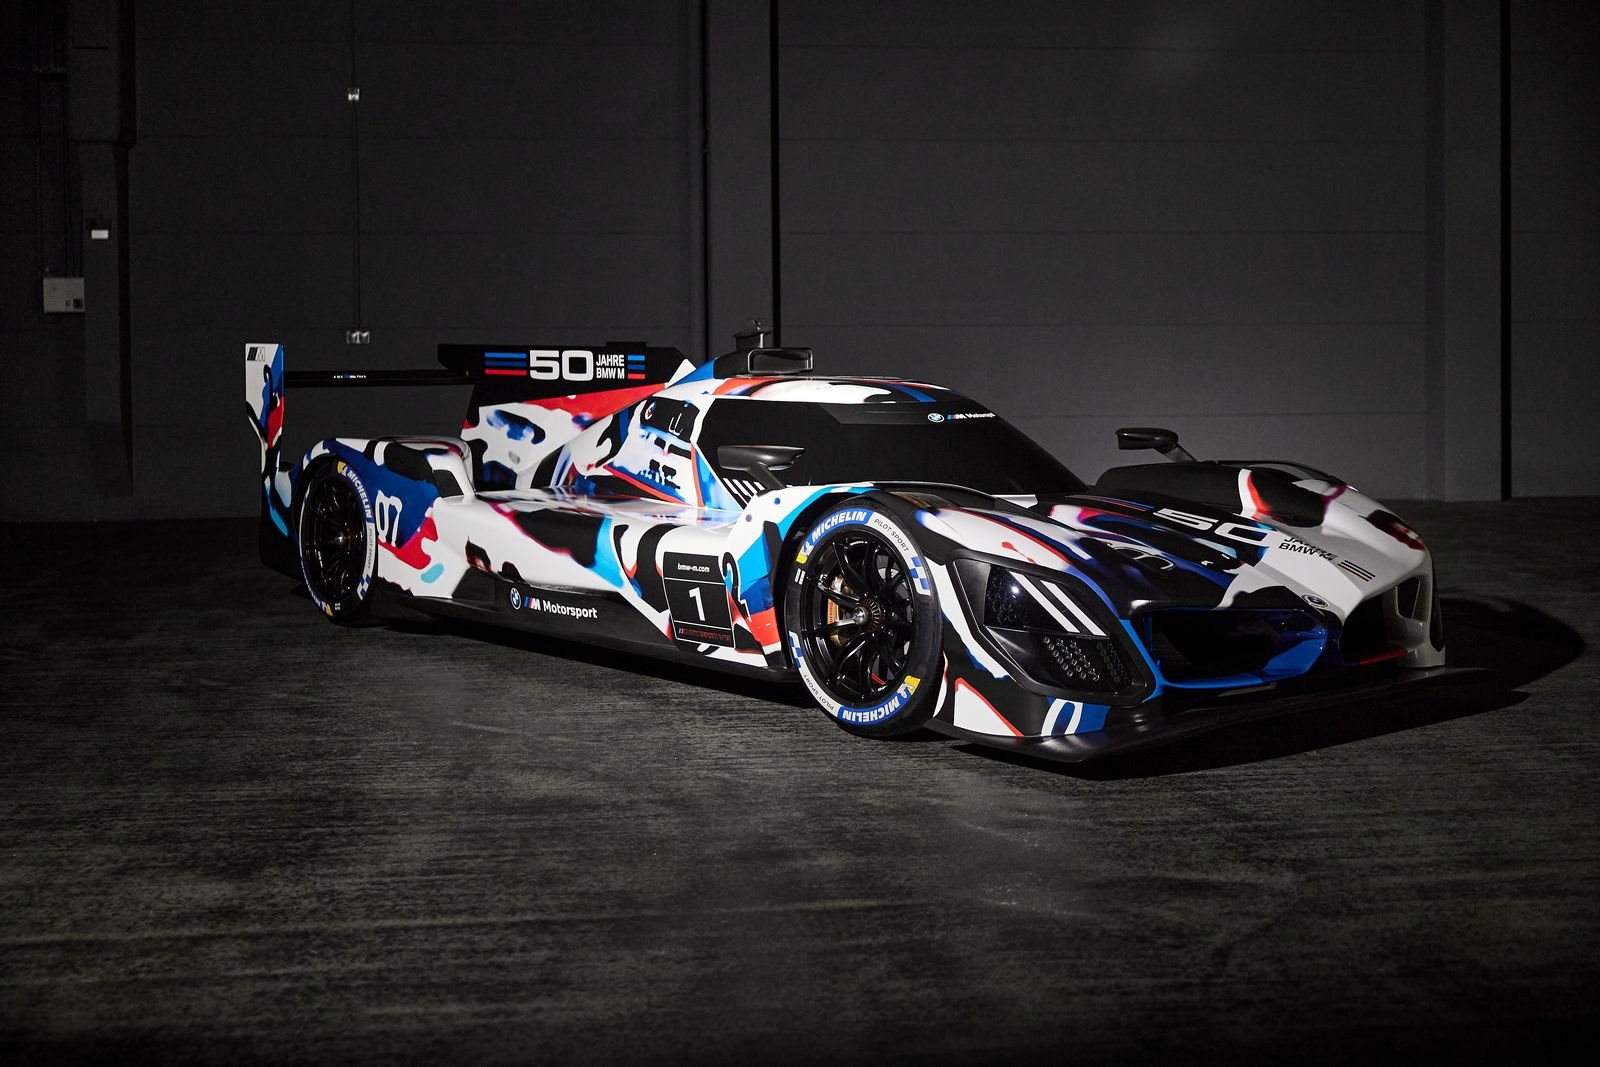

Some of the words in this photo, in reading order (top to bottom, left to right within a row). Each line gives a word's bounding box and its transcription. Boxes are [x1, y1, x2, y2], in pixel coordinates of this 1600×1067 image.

[529, 349, 594, 382] 50
[596, 354, 625, 367] JAHRE
[596, 368, 617, 379] BMW
[617, 368, 625, 379] M
[346, 469, 372, 519] MICHELIN
[811, 511, 868, 543] MICHELIN
[873, 518, 892, 532] PILOT
[891, 531, 910, 553] SPORT
[1152, 508, 1279, 547] 50
[1279, 542, 1317, 555] BMW
[677, 563, 710, 573] bmw-m.com
[542, 600, 598, 620] Motorsport
[688, 587, 706, 622] 1
[803, 674, 819, 696] SPORT
[818, 695, 834, 711] PILOT
[842, 695, 901, 722] MICHELIN
